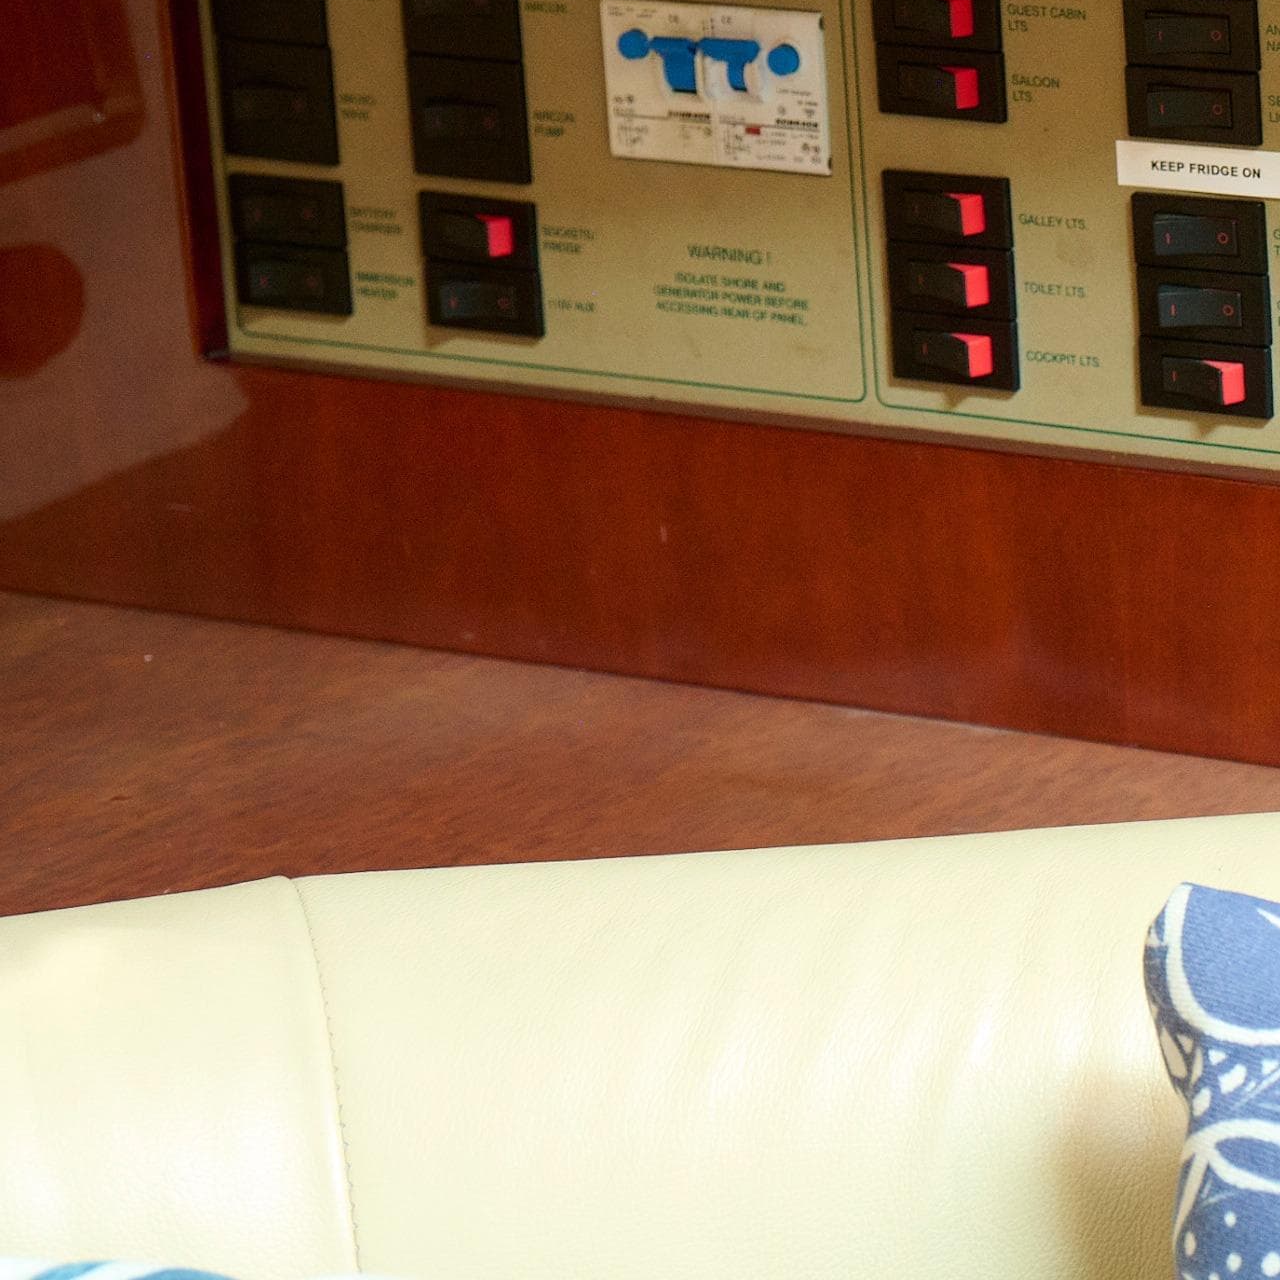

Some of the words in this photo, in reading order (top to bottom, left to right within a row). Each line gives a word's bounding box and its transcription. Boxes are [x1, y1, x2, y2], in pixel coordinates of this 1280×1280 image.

[1007, 3, 1047, 18] GUEST
[1050, 6, 1087, 21] CABIN
[1011, 73, 1060, 89] SALOON
[1150, 159, 1186, 174] KEEP
[1188, 162, 1239, 178] FRIDGE
[1241, 166, 1262, 180] ON
[1018, 213, 1063, 228] GALLEY
[687, 244, 763, 265] WARNING
[1023, 281, 1063, 296] TOILET
[1026, 350, 1076, 366] COCKPIT
